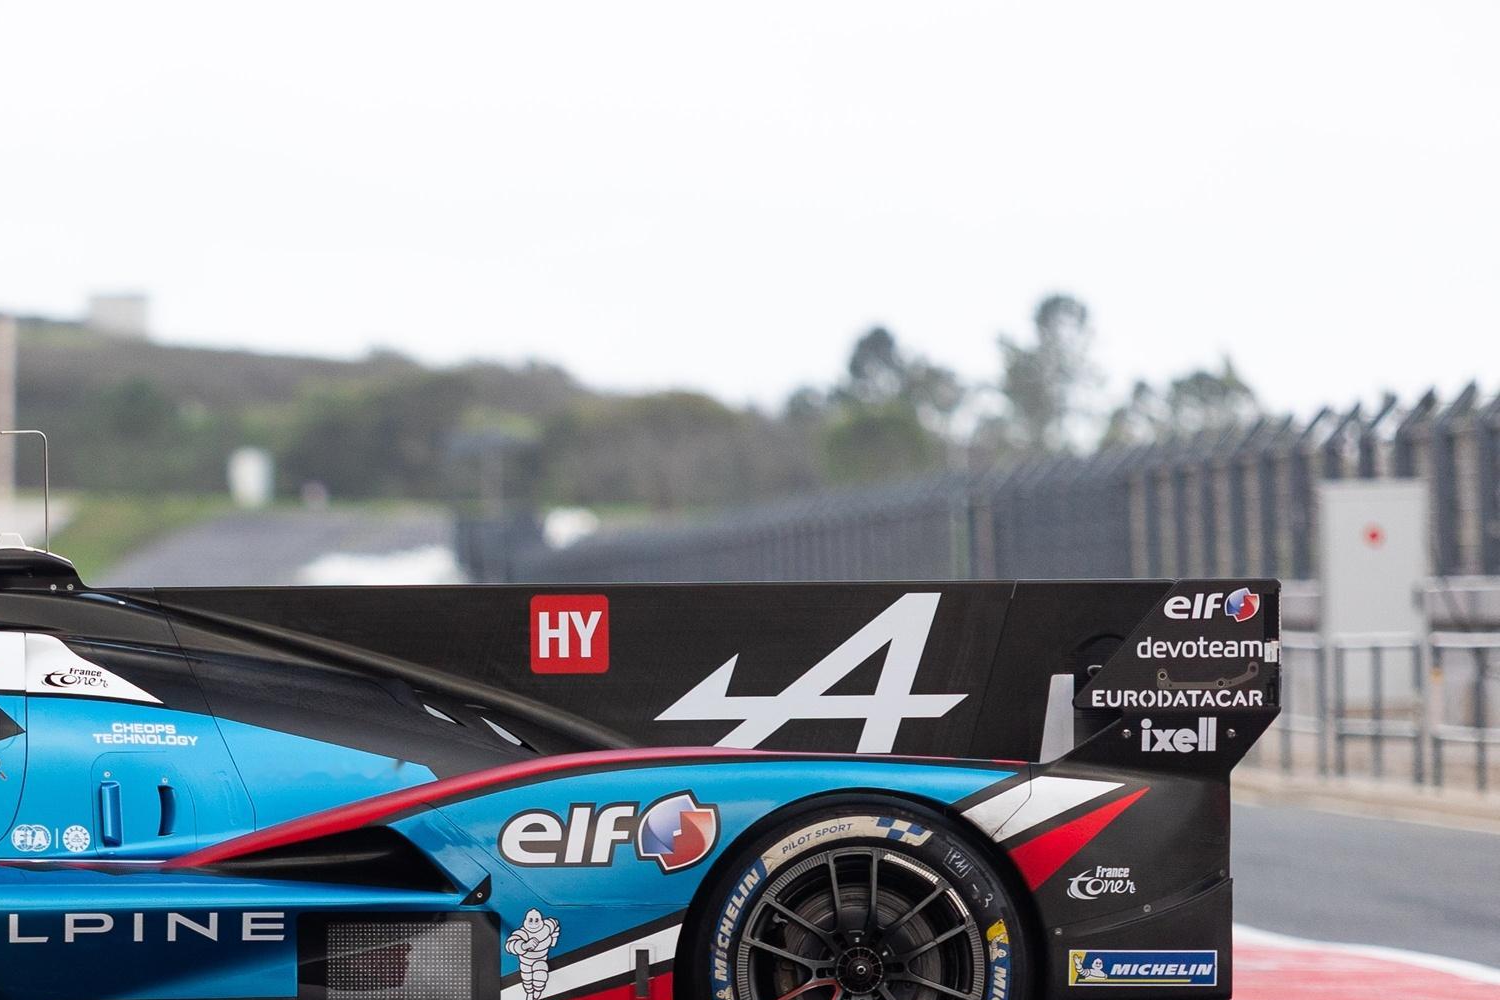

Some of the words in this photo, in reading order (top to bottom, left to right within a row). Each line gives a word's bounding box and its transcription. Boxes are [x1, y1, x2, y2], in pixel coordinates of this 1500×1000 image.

[1164, 593, 1223, 619] elf
[539, 611, 602, 658] HY
[1137, 636, 1263, 658] devoteam
[69, 667, 102, 677] France
[1092, 690, 1263, 707] EURODATACAR
[92, 733, 198, 746] TECHNOLOGY
[112, 723, 176, 734] CHEOPS
[1141, 717, 1217, 753] ixell
[12, 829, 49, 848] FIA
[501, 806, 635, 863] elf
[782, 833, 811, 854] PILOT
[815, 823, 854, 838] SPORT
[1096, 866, 1130, 877] France
[1067, 869, 1136, 900] toner
[714, 868, 760, 981] MICHELIN
[1111, 964, 1213, 976] MICHELIN
